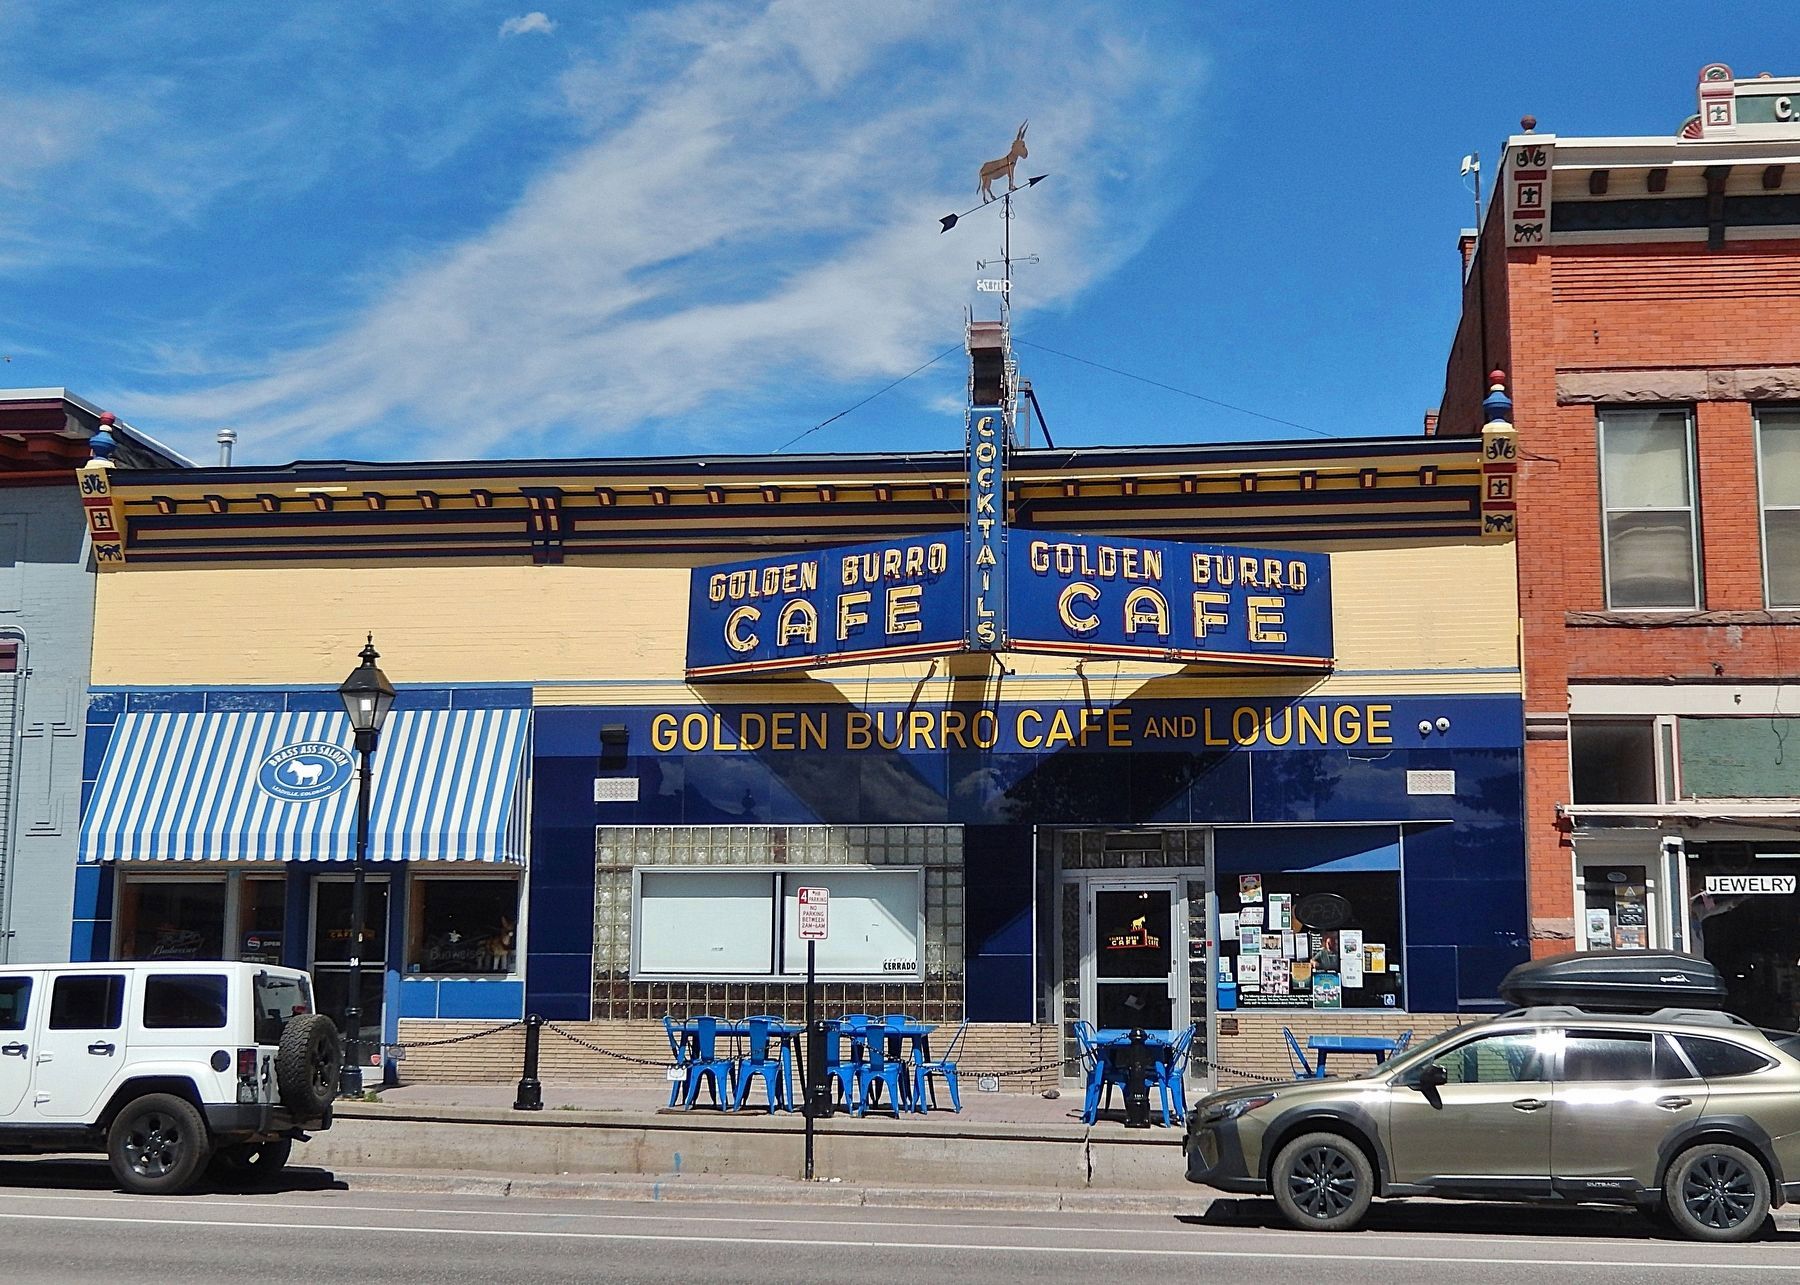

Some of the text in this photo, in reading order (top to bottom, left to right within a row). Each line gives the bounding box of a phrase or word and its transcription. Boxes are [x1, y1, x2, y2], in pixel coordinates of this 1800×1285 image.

[976, 415, 998, 643] COCKTAILS
[709, 543, 947, 602] GOLDEN BURRO
[1030, 540, 1307, 590] GOLDEN BURRO
[725, 584, 923, 652] CAFE
[1058, 581, 1288, 643] CAFE
[650, 704, 1393, 752] GOLDEN BURRO CAFE AND LOUNGE
[268, 745, 350, 767] BRASS ASS SALOON
[300, 785, 332, 797] COLORADO
[800, 890, 808, 904] 4
[1708, 877, 1794, 892] JEWELRY
[883, 962, 916, 971] CERRADO
